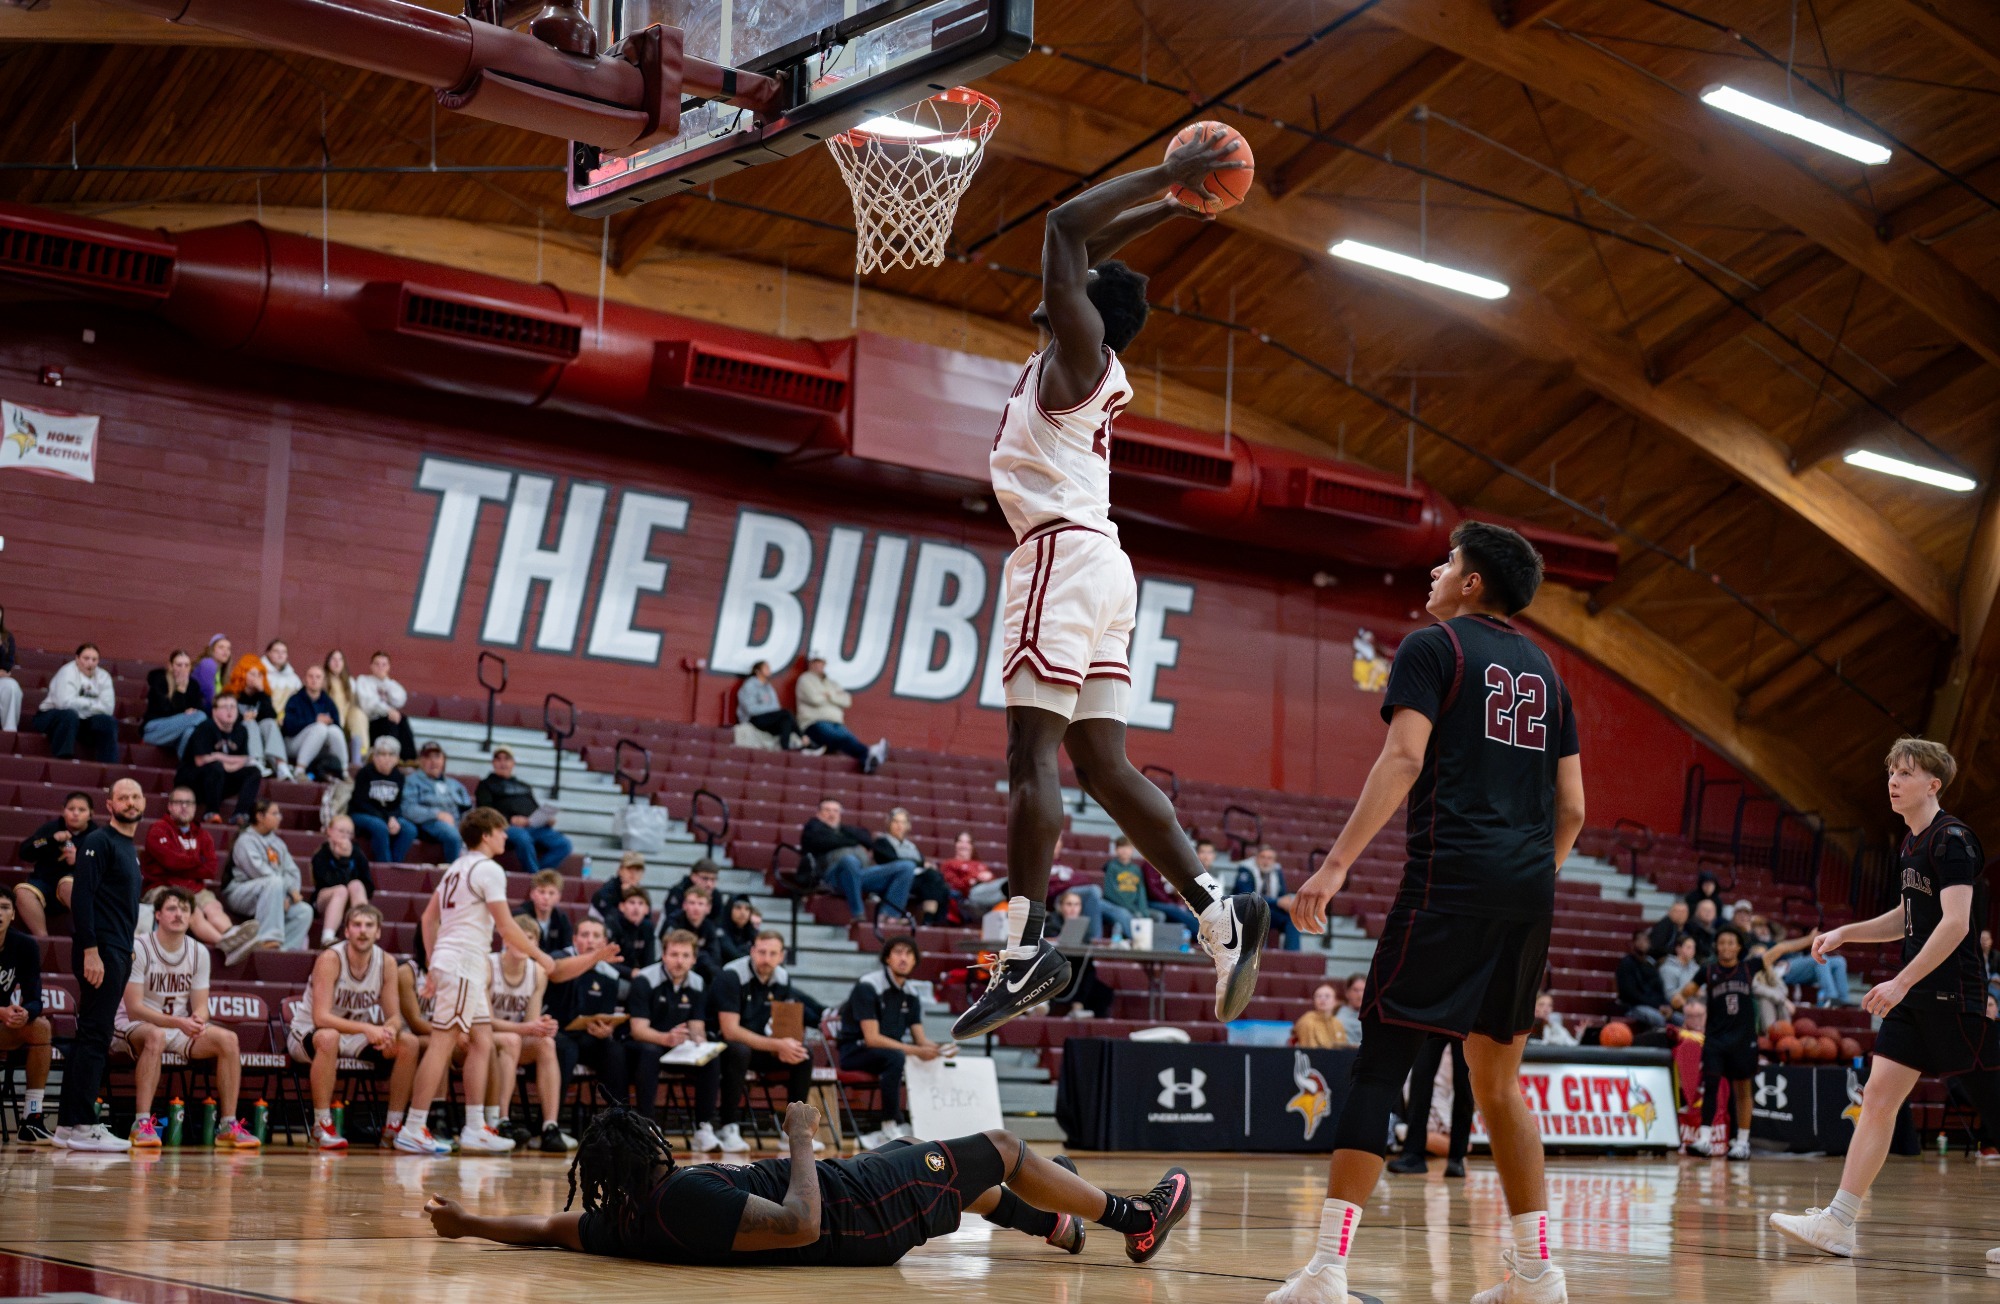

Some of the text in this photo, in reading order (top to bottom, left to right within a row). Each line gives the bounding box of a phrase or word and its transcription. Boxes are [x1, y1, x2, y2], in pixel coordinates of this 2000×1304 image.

[46, 430, 83, 446] HOME
[37, 445, 90, 462] SECTION
[407, 455, 1194, 732] THE BUBE
[1484, 662, 1547, 752] 22
[442, 872, 460, 909] 12
[149, 972, 193, 993] VIKINGS
[162, 996, 177, 1016] 5
[207, 995, 260, 1019] VCSU
[334, 987, 377, 1010] VIKINGS
[239, 1053, 286, 1067] VIKINGS
[1561, 1075, 1632, 1113] CITY
[1535, 1113, 1638, 1136] IVERSITY
